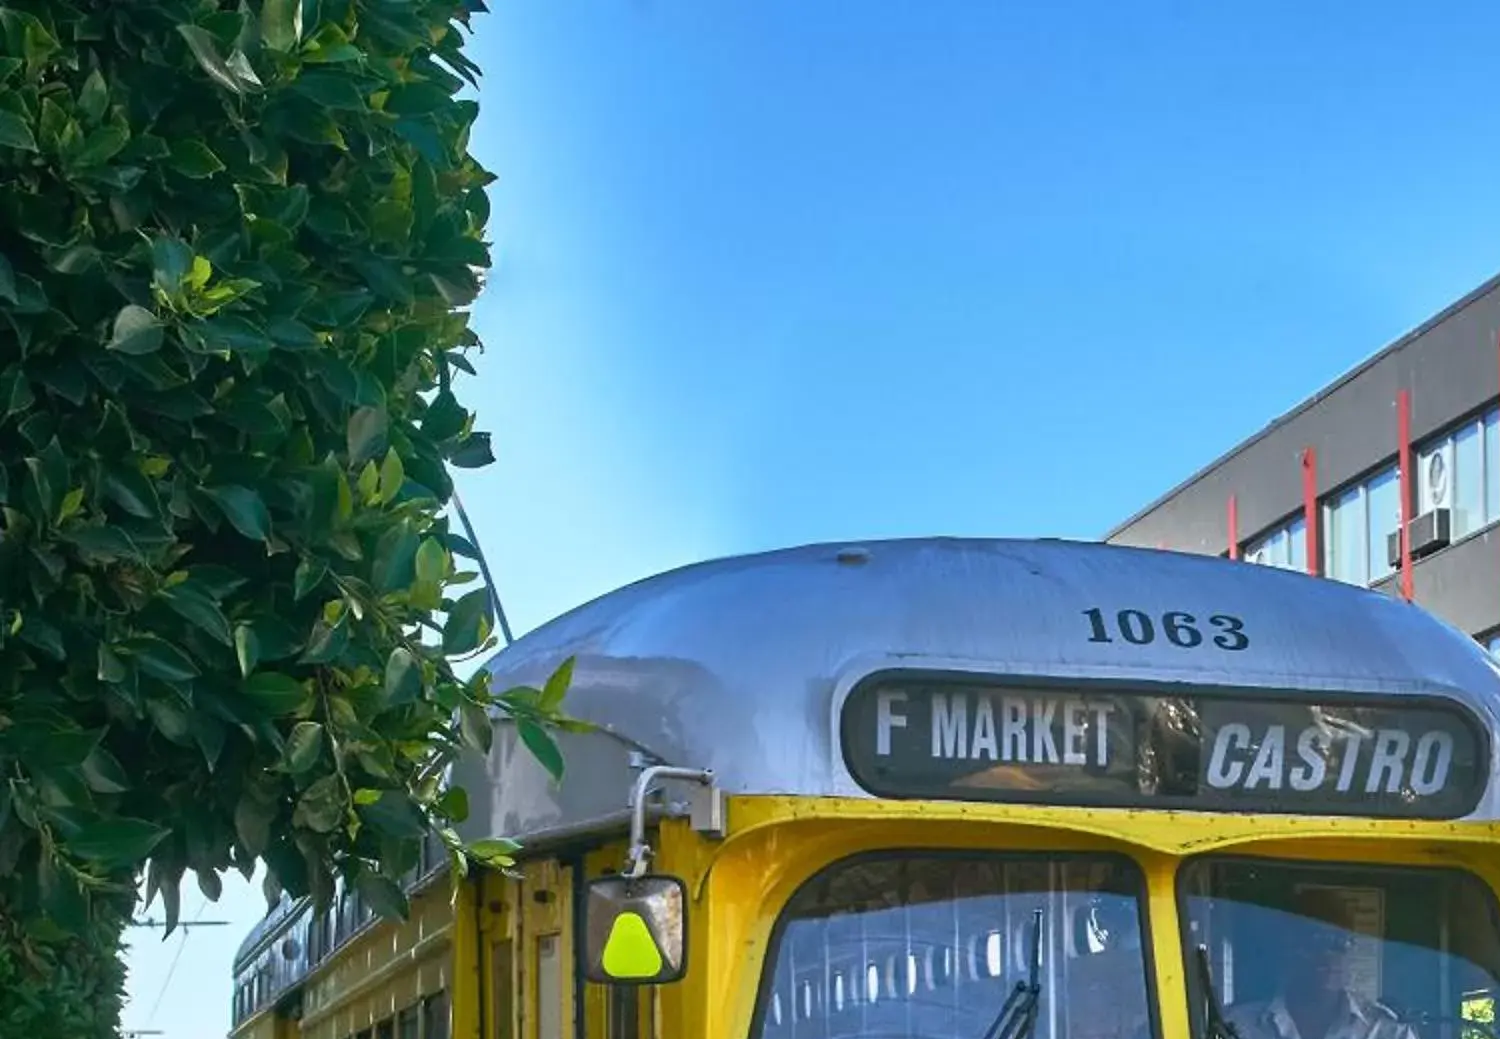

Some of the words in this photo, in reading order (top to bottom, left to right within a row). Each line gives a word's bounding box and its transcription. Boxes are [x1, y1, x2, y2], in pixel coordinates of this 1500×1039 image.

[1082, 607, 1250, 651] 1063
[875, 689, 909, 756] F
[931, 691, 1116, 768] MARKET
[1207, 722, 1454, 796] CASTRO
